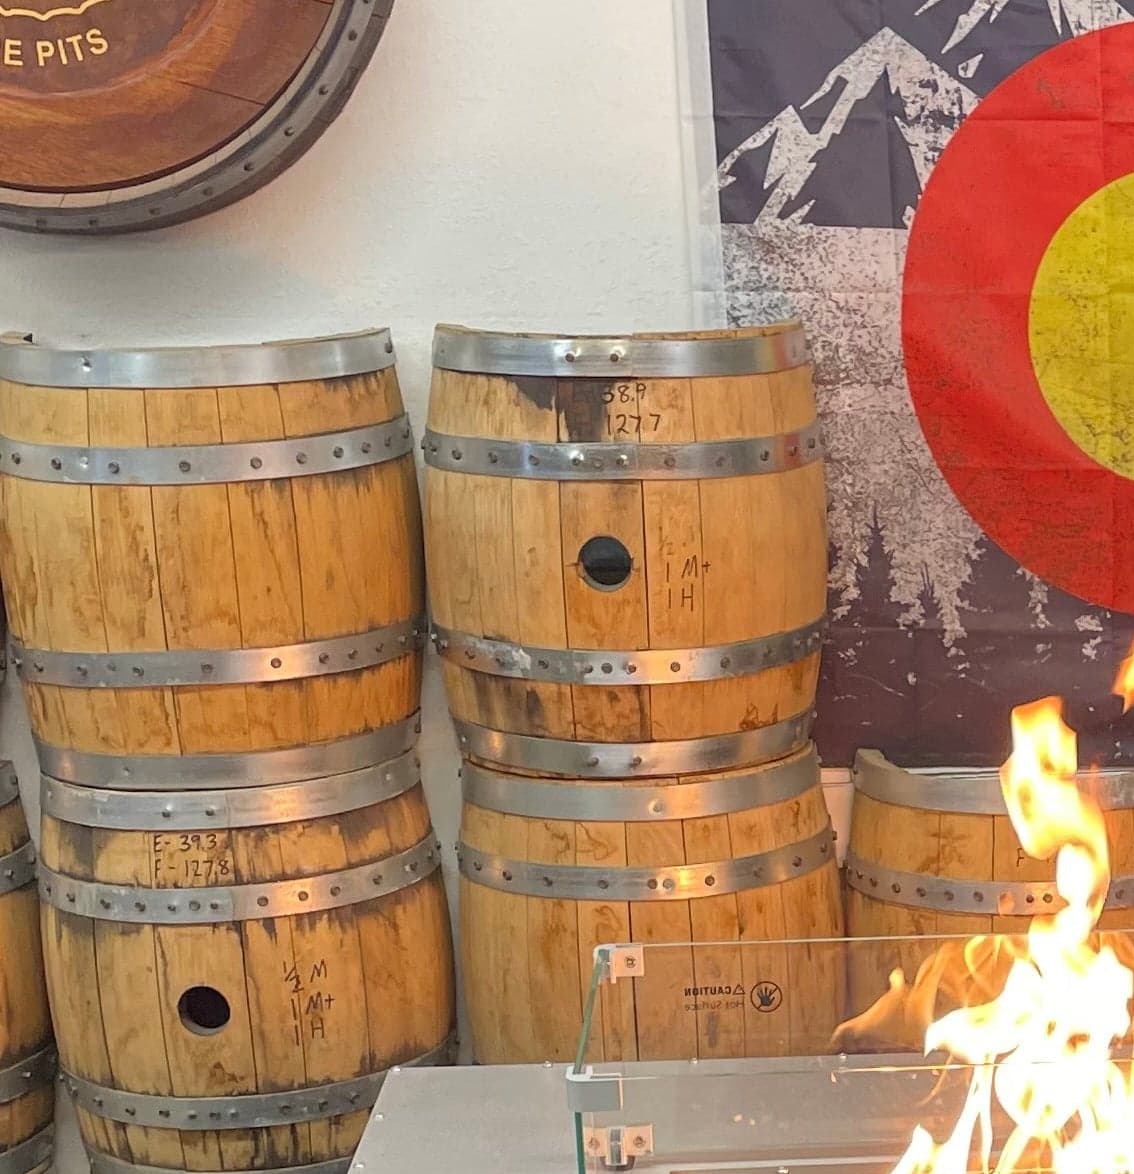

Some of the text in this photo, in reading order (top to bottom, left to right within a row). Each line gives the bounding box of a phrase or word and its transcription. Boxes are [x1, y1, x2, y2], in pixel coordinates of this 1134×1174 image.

[36, 28, 109, 67] PITS
[680, 583, 694, 612] H
[310, 958, 328, 983] M
[310, 1016, 325, 1040] H
